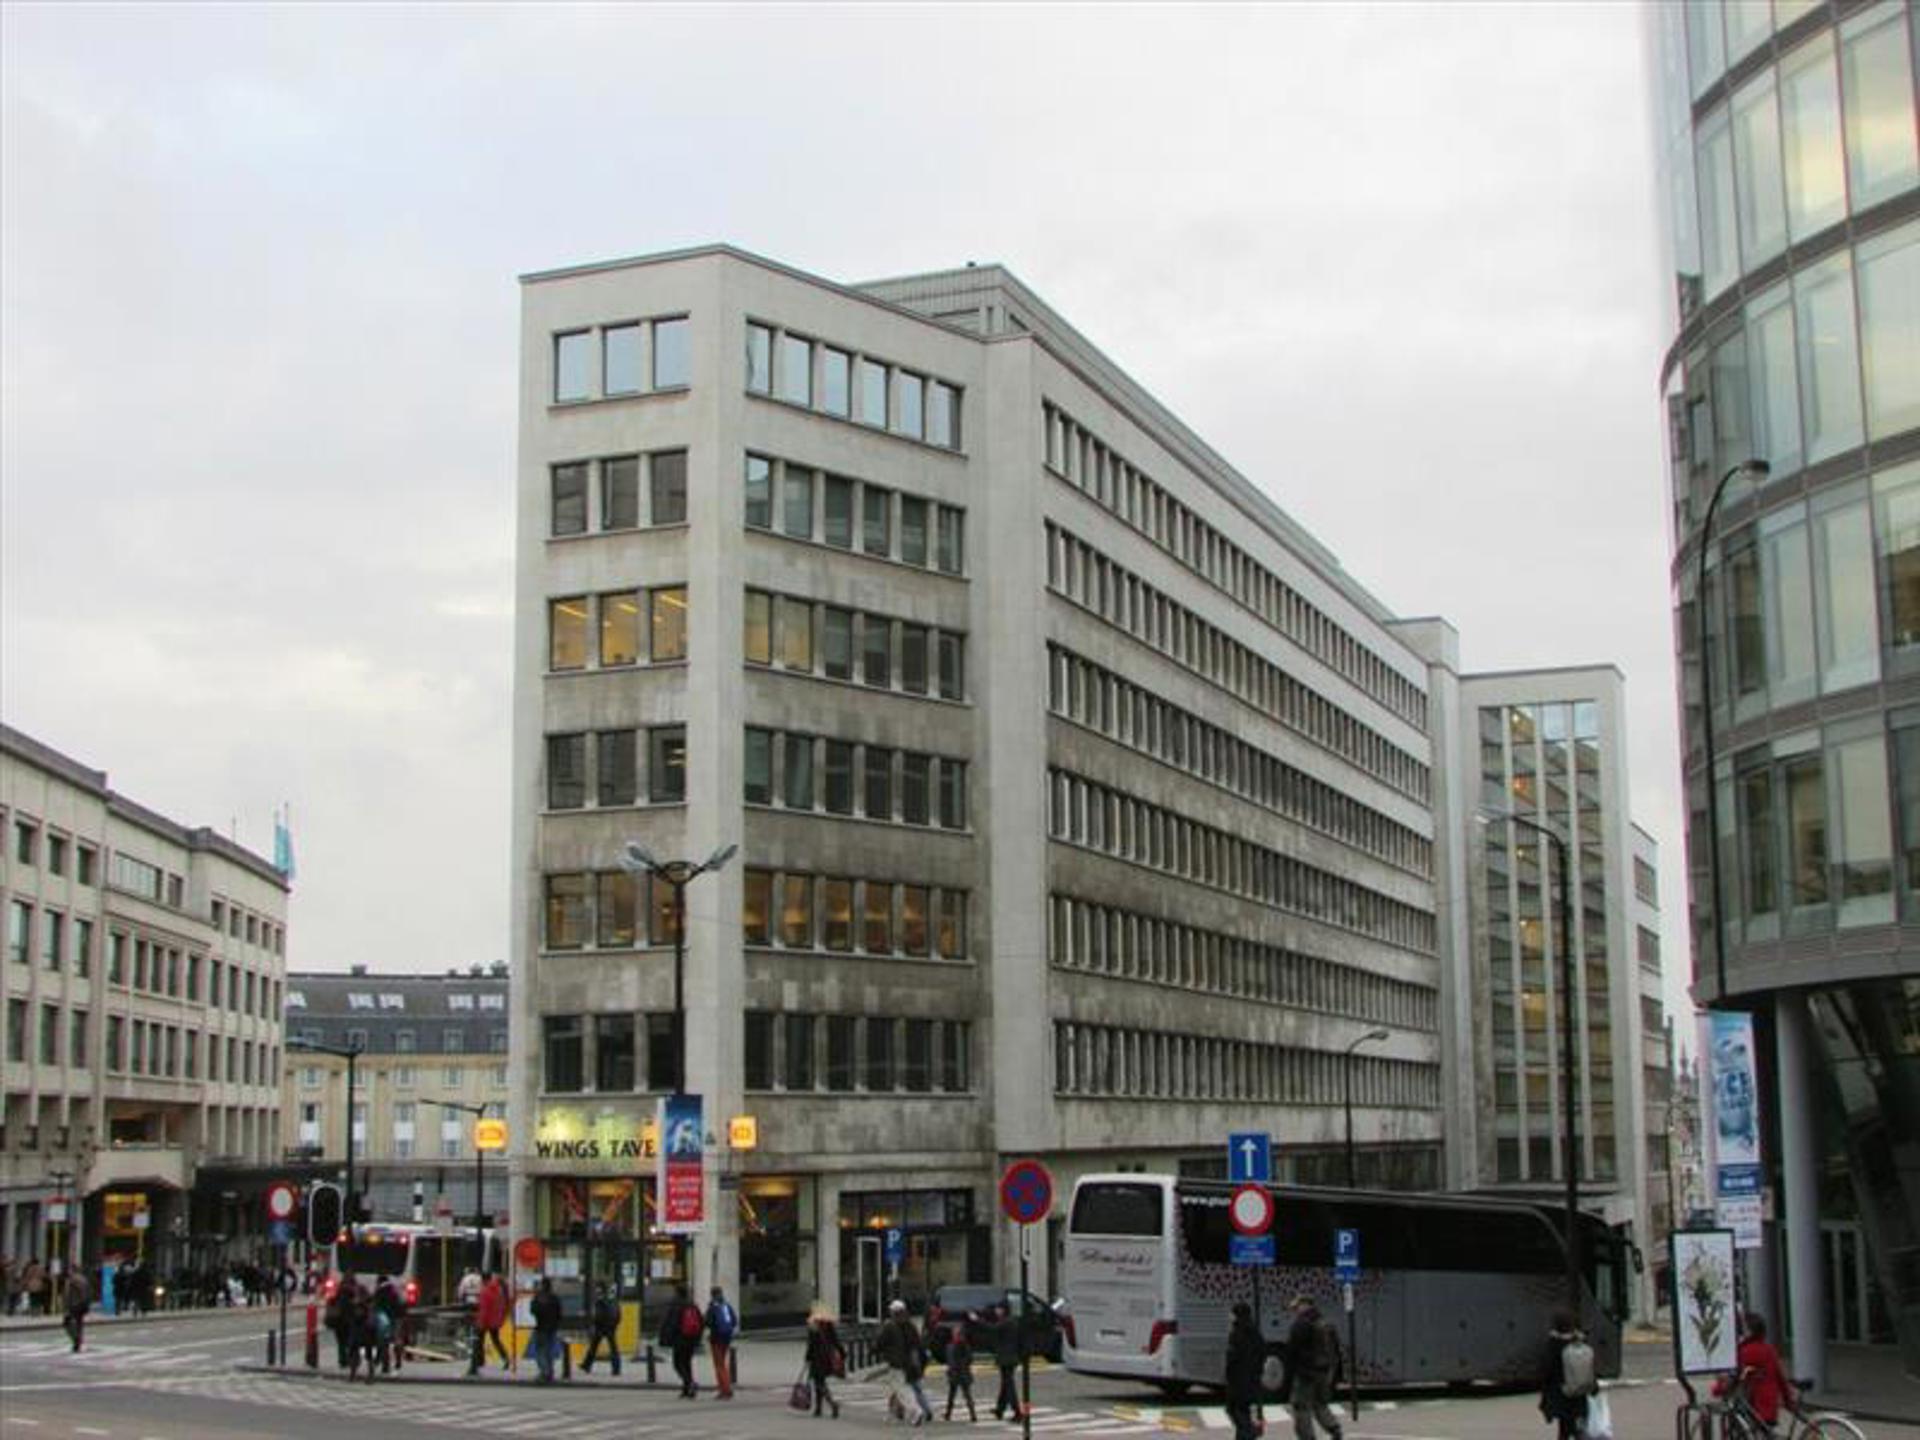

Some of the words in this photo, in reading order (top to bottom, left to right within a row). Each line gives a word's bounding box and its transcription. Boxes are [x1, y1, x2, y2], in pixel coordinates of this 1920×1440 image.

[536, 1140, 599, 1158] WINGS
[887, 1230, 900, 1248] P
[1339, 1232, 1353, 1254] P
